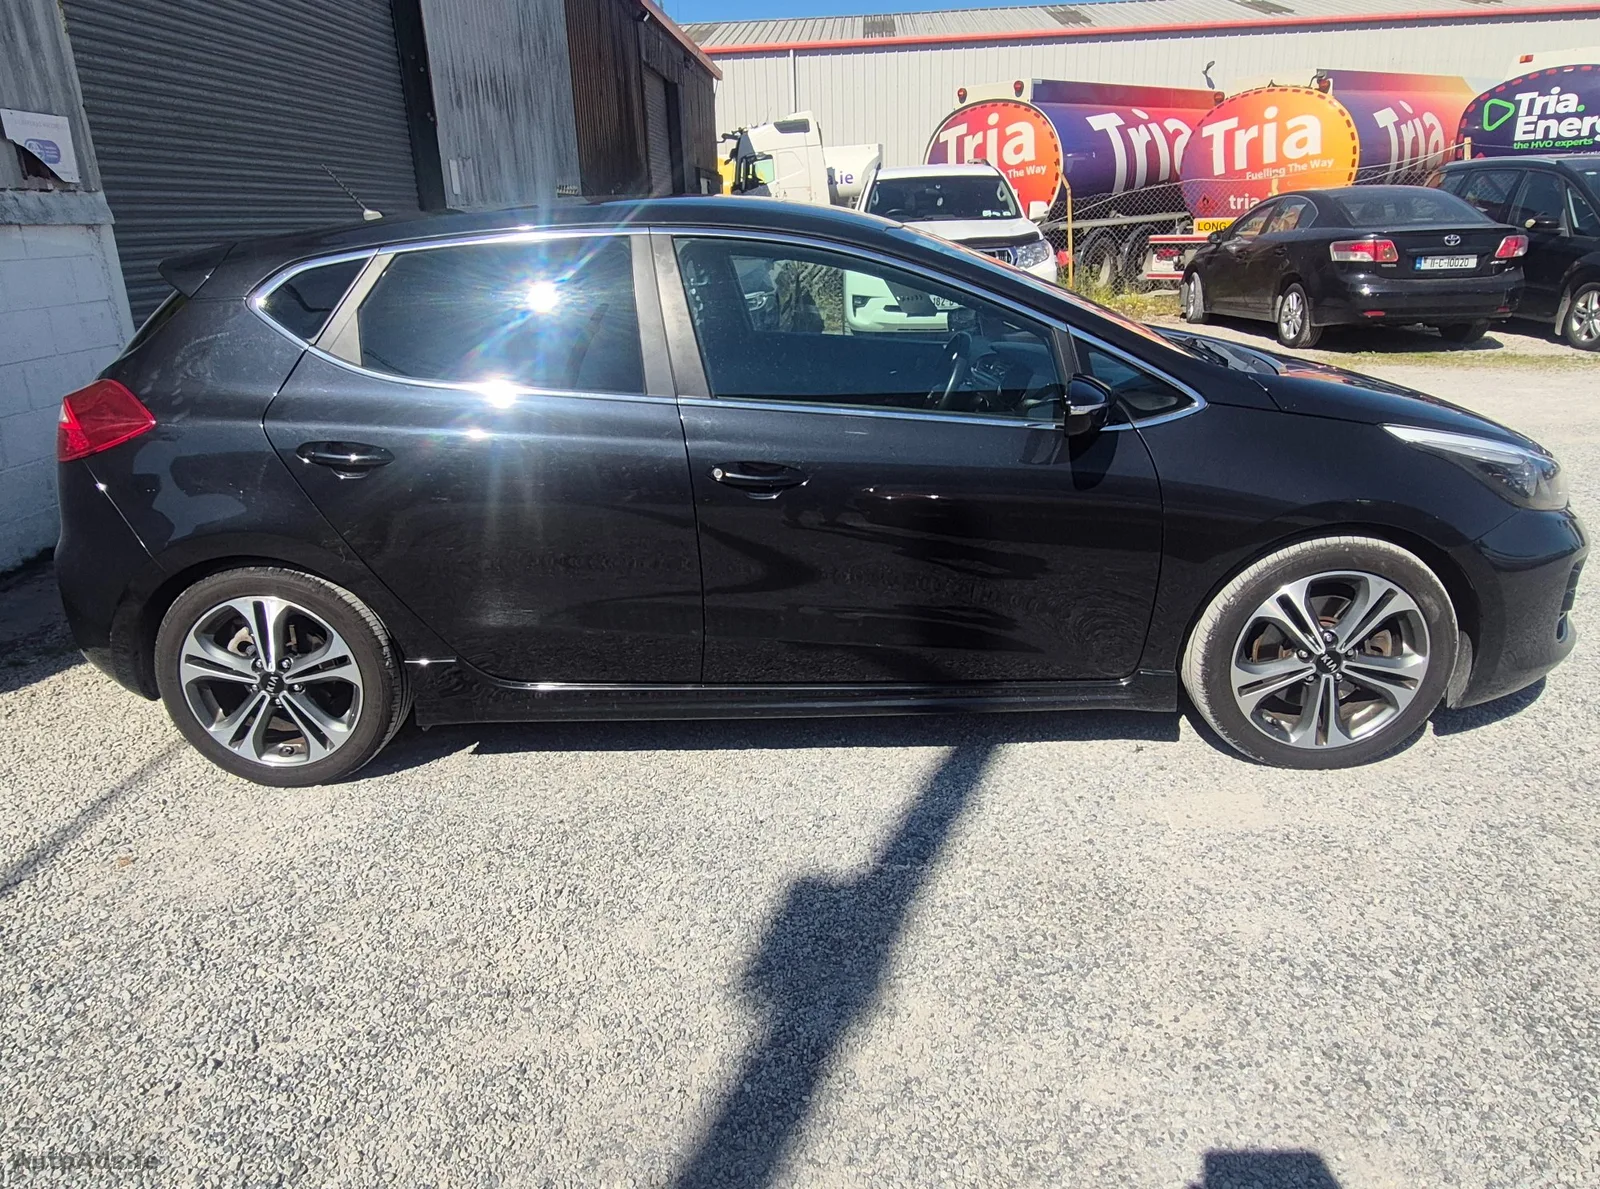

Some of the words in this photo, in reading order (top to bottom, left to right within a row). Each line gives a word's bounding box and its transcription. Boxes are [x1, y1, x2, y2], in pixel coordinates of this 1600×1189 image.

[1515, 86, 1585, 116] Tria.
[940, 112, 1036, 167] Tria
[1514, 115, 1600, 142] Ener
[1086, 108, 1192, 195] Tria
[1202, 106, 1321, 176] Tria
[1373, 100, 1445, 185] Tria
[1530, 140, 1553, 149] HVO
[1555, 138, 1593, 148] experts
[1007, 168, 1025, 178] The
[1026, 165, 1047, 176] Way
[1246, 168, 1286, 180] Fuelling
[1288, 162, 1308, 173] The
[1310, 158, 1335, 169] Way
[1197, 222, 1227, 232] LONG
[1430, 257, 1470, 268] 11-C-10020
[1320, 653, 1338, 672] KIA
[266, 676, 279, 693] KIA
